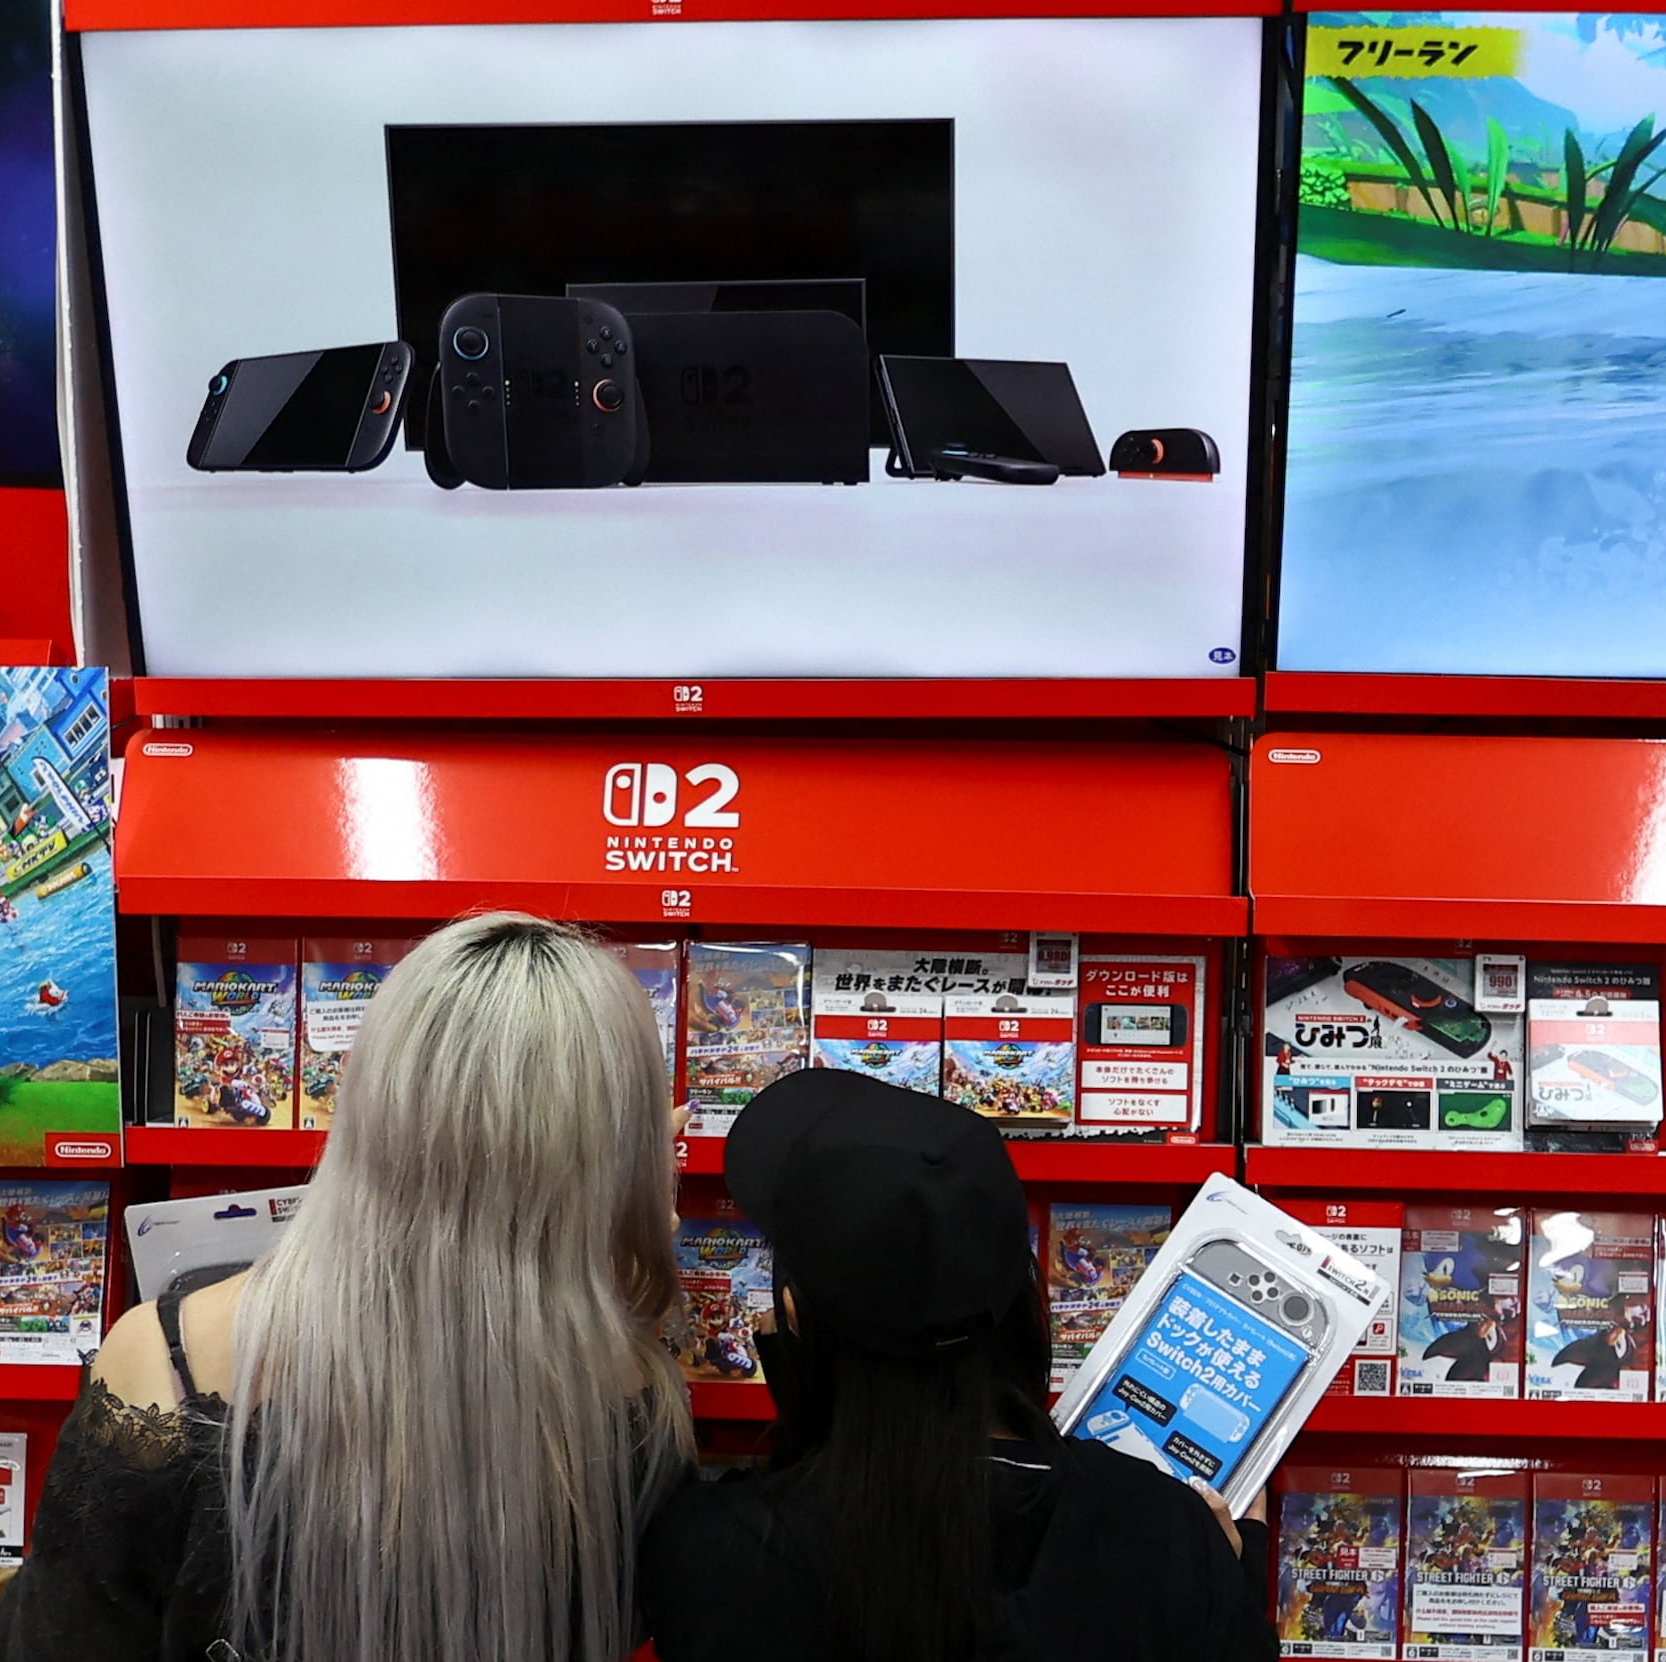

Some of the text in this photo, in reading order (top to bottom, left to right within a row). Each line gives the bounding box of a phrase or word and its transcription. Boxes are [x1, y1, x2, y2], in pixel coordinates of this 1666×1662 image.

[1334, 37, 1480, 69] フリーラン
[691, 686, 702, 701] 2
[146, 745, 190, 756] Nintendo
[1271, 750, 1318, 762] Nintendo
[685, 764, 739, 827] 2
[607, 837, 732, 850] NINTENDO
[606, 851, 731, 872] SWITCH
[679, 891, 690, 906] 2
[1086, 970, 1188, 983] ダウンロード版は
[1106, 984, 1169, 998] ここが便利
[59, 1144, 107, 1156] Nintendo
[1167, 1295, 1267, 1369] 装着したまま
[1156, 1312, 1262, 1390] ドックが使える
[1291, 1569, 1327, 1581] STREET
[1329, 1569, 1368, 1582] FIGHTER
[1417, 1572, 1453, 1583] STREET
[1455, 1572, 1493, 1585] FIGHTER
